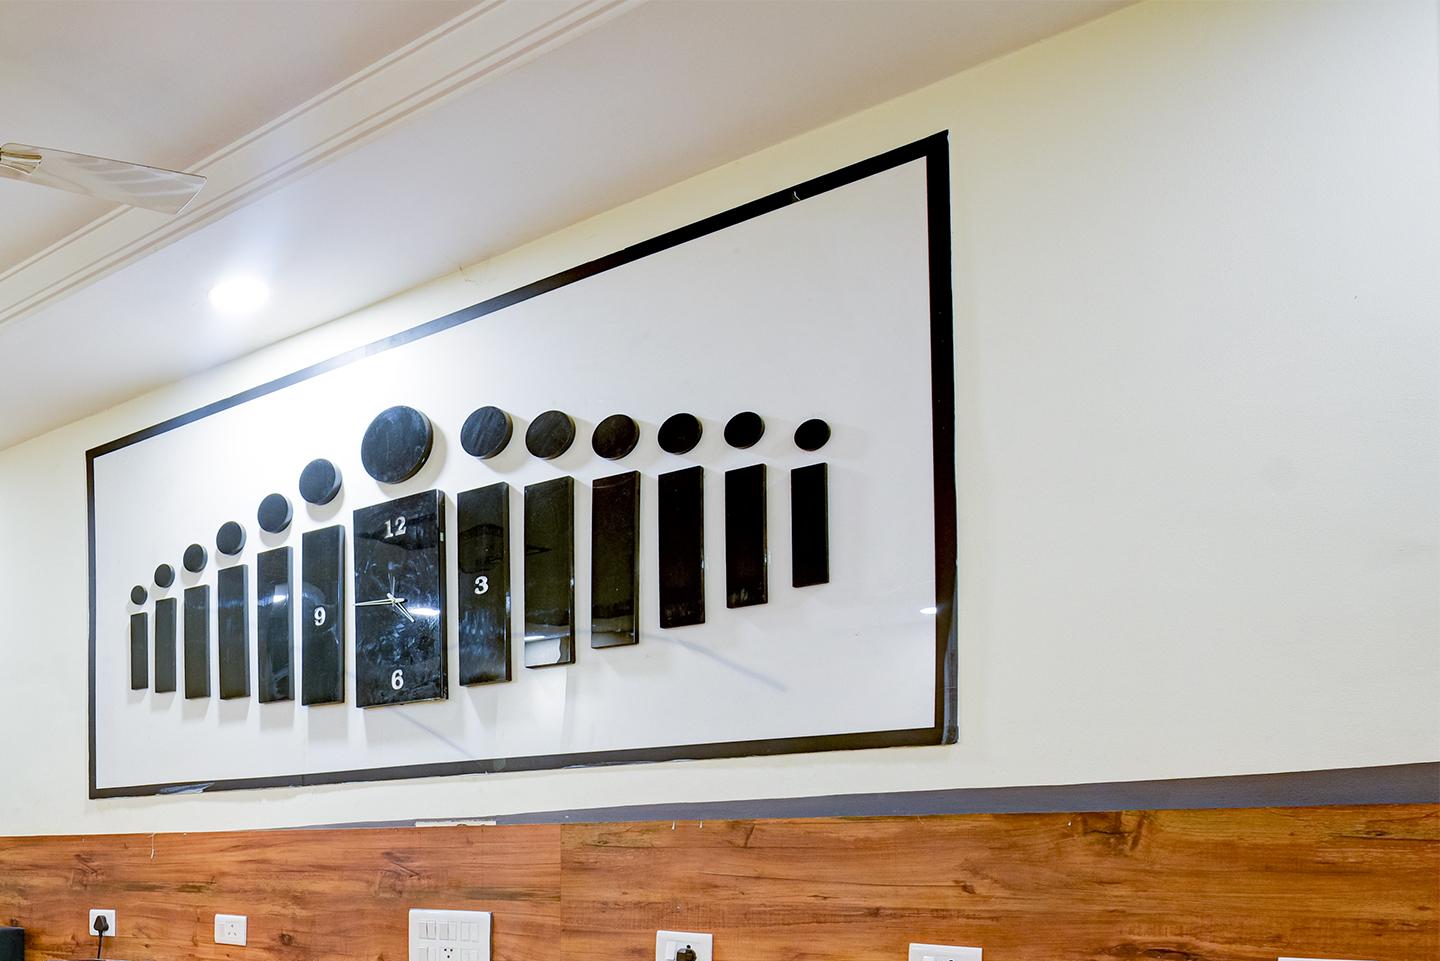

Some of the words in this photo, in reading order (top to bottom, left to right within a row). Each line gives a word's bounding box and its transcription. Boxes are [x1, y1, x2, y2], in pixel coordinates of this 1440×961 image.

[384, 516, 406, 538] 12
[475, 576, 489, 595] 3
[314, 607, 326, 626] 9
[391, 669, 404, 690] 6
